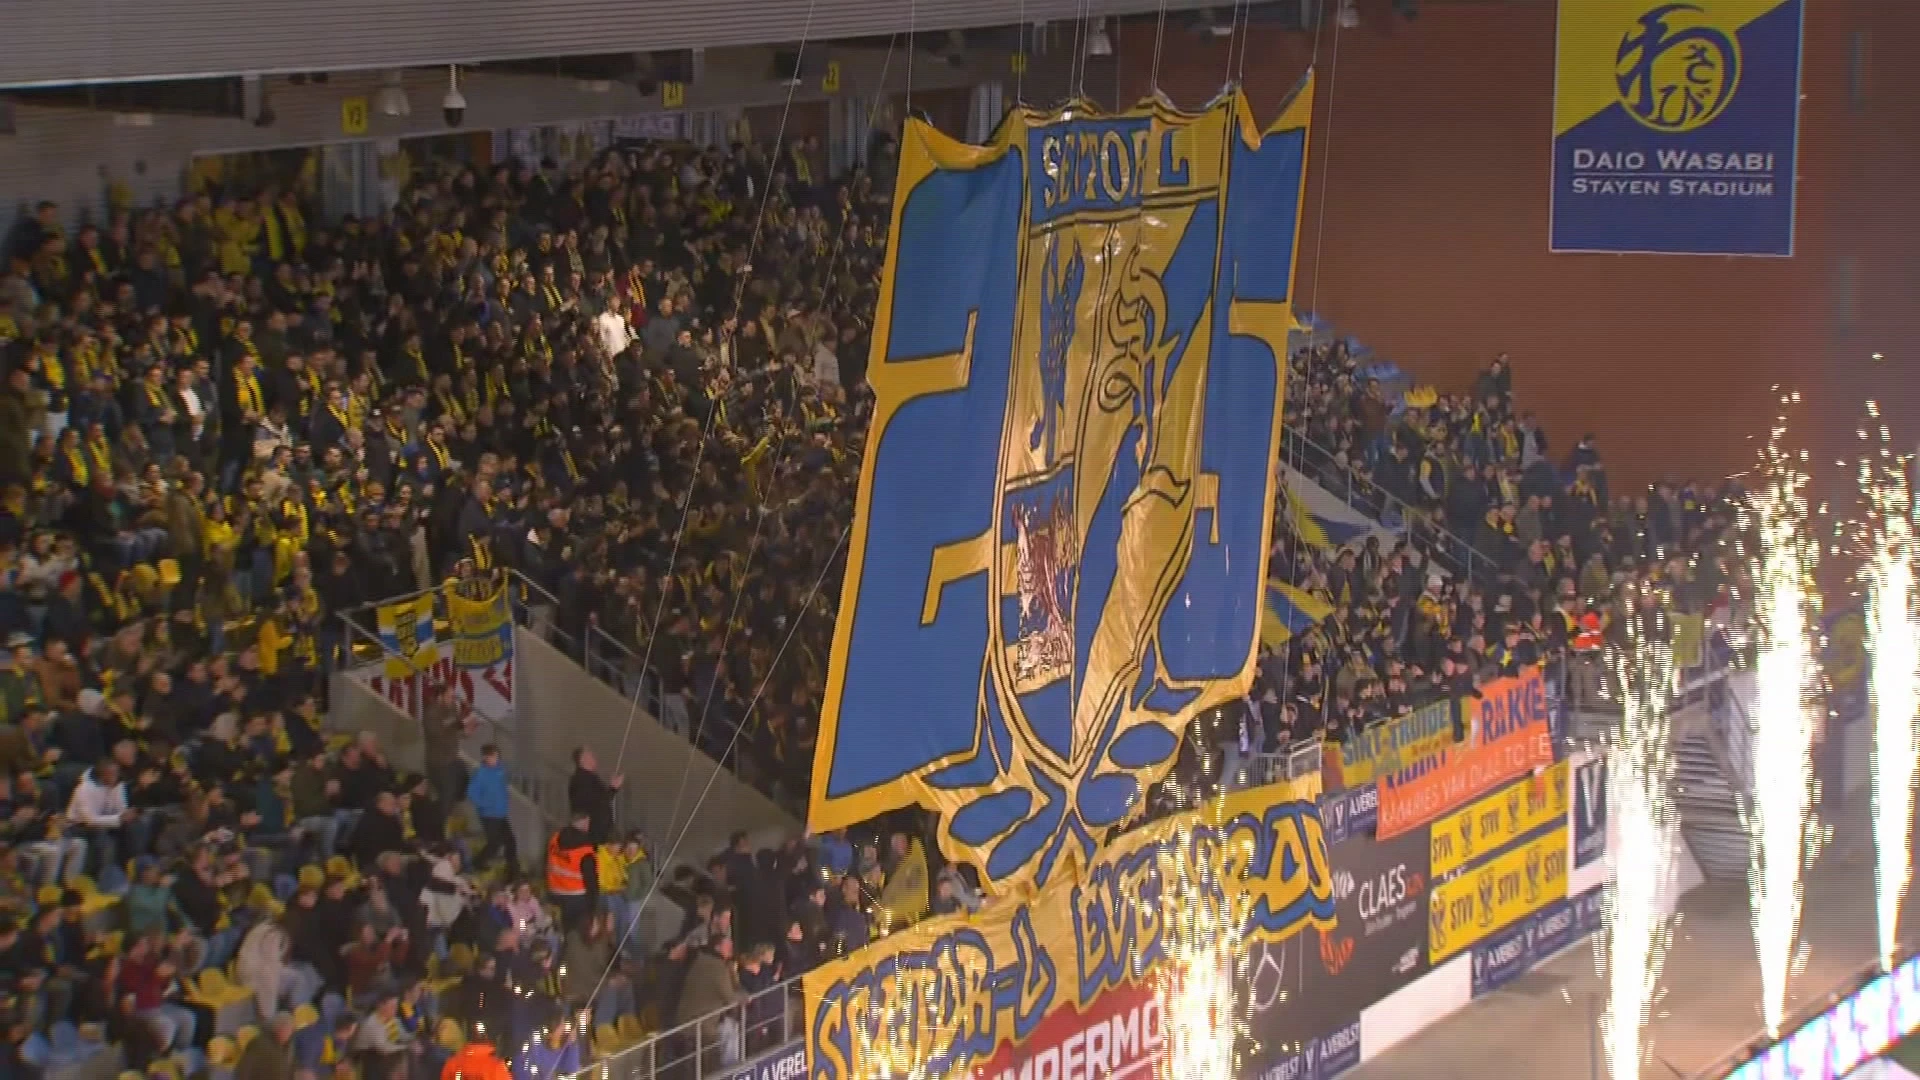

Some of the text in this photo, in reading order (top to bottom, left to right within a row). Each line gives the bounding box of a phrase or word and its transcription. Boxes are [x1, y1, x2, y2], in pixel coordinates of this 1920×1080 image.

[1572, 148, 1774, 171] DAIO WASABI
[1572, 178, 1774, 197] STAYEN STADIUM
